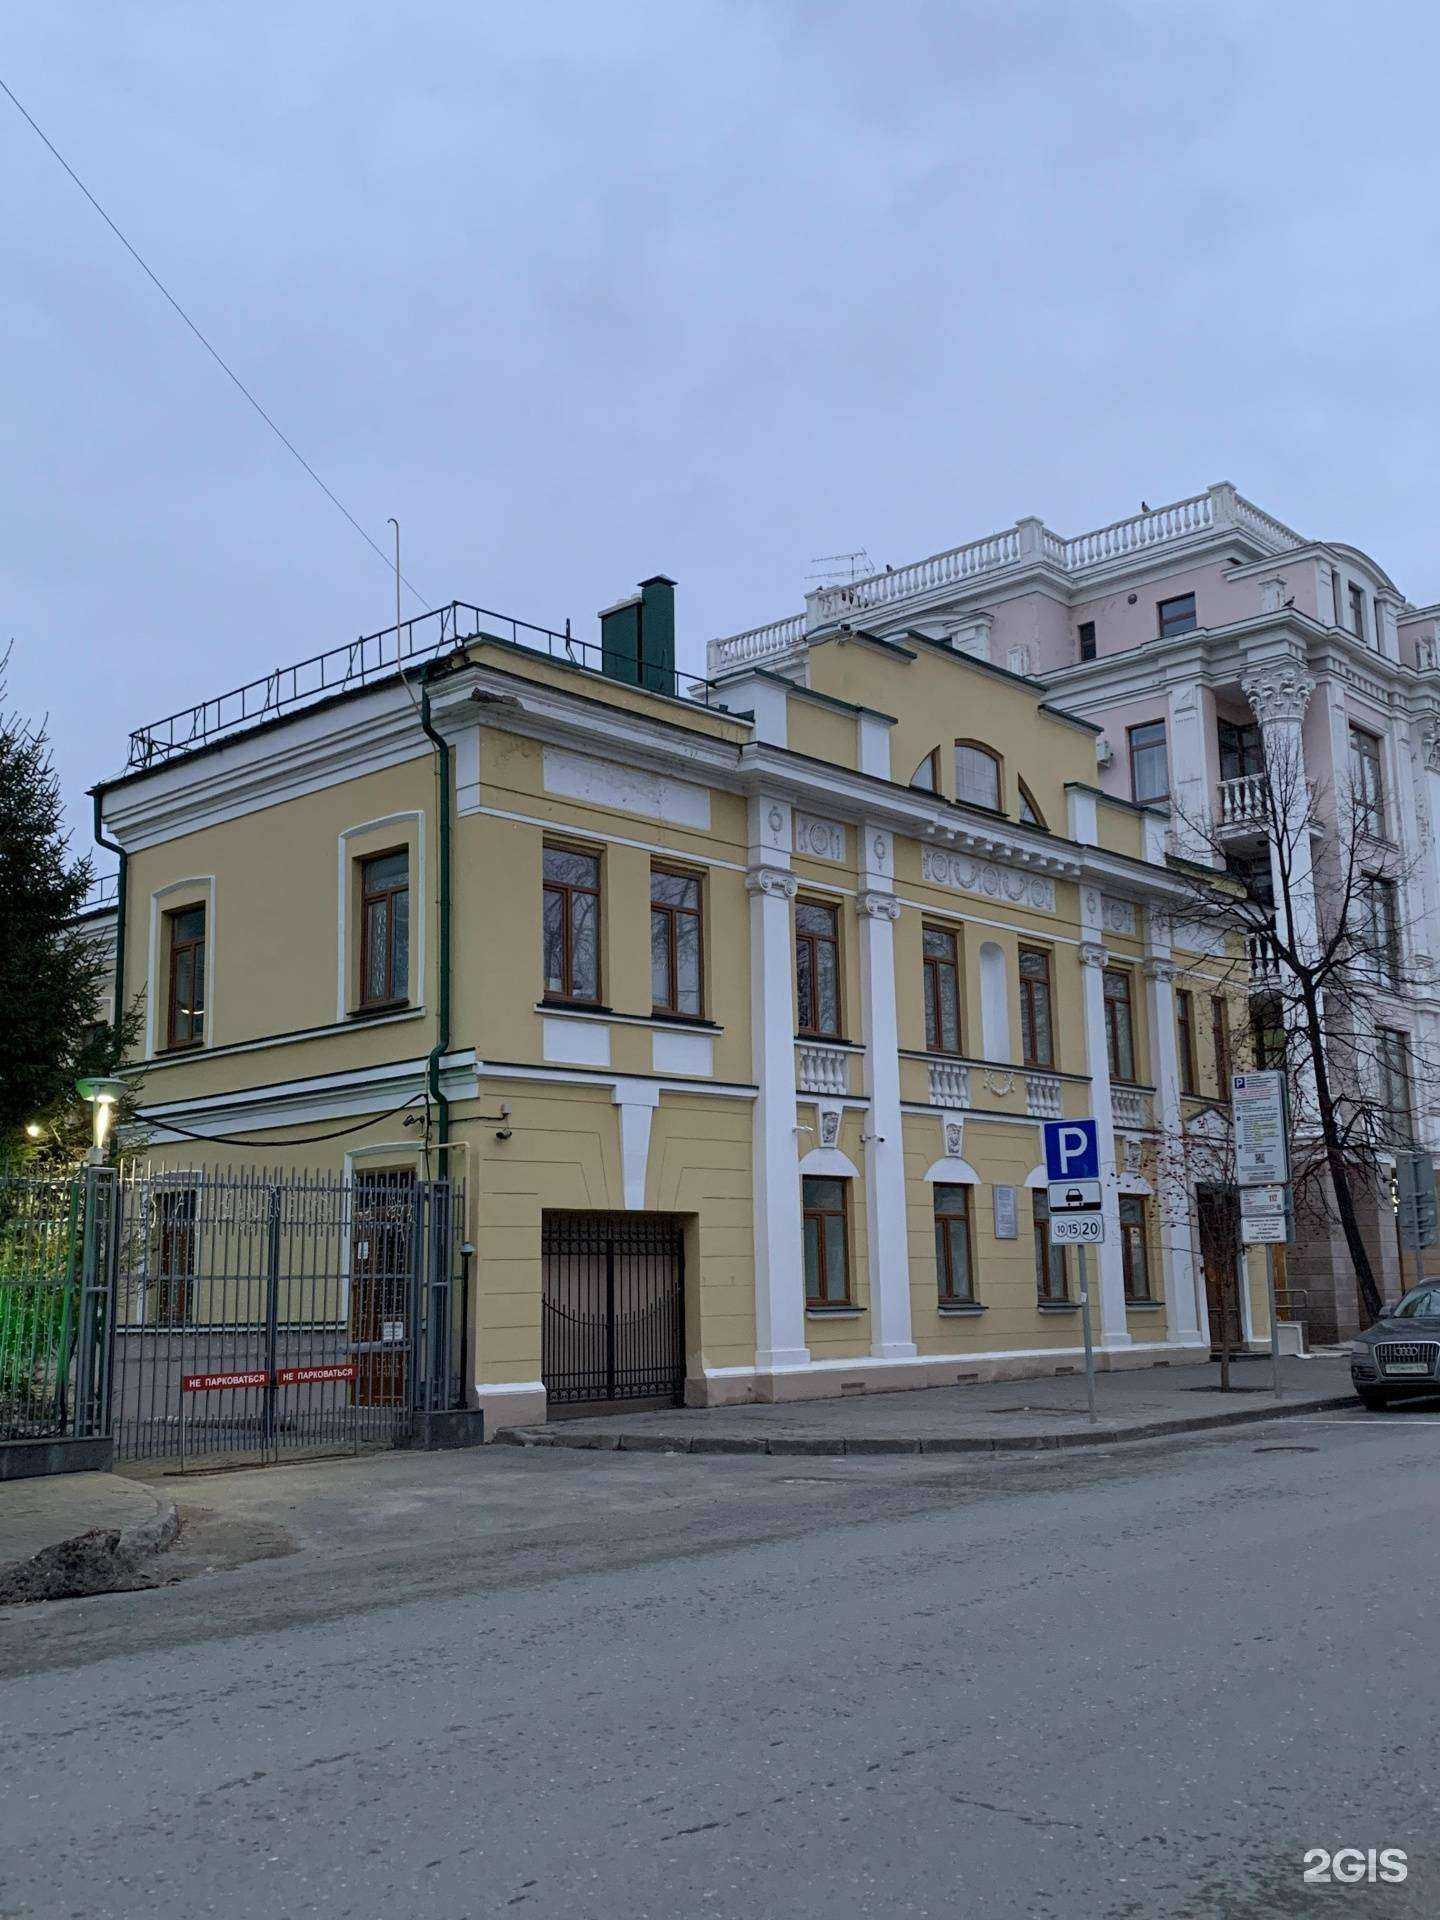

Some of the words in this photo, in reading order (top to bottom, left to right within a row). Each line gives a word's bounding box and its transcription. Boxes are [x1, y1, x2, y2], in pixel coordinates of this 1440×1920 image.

[1058, 1127, 1088, 1174] P
[1057, 1225, 1066, 1234] 10
[1068, 1223, 1078, 1234] 15
[1082, 1222, 1098, 1235] 20
[282, 1372, 294, 1381] НЕ
[297, 1368, 353, 1380] ПАРКОВАТЬСЯ
[189, 1379, 201, 1388] НЕ
